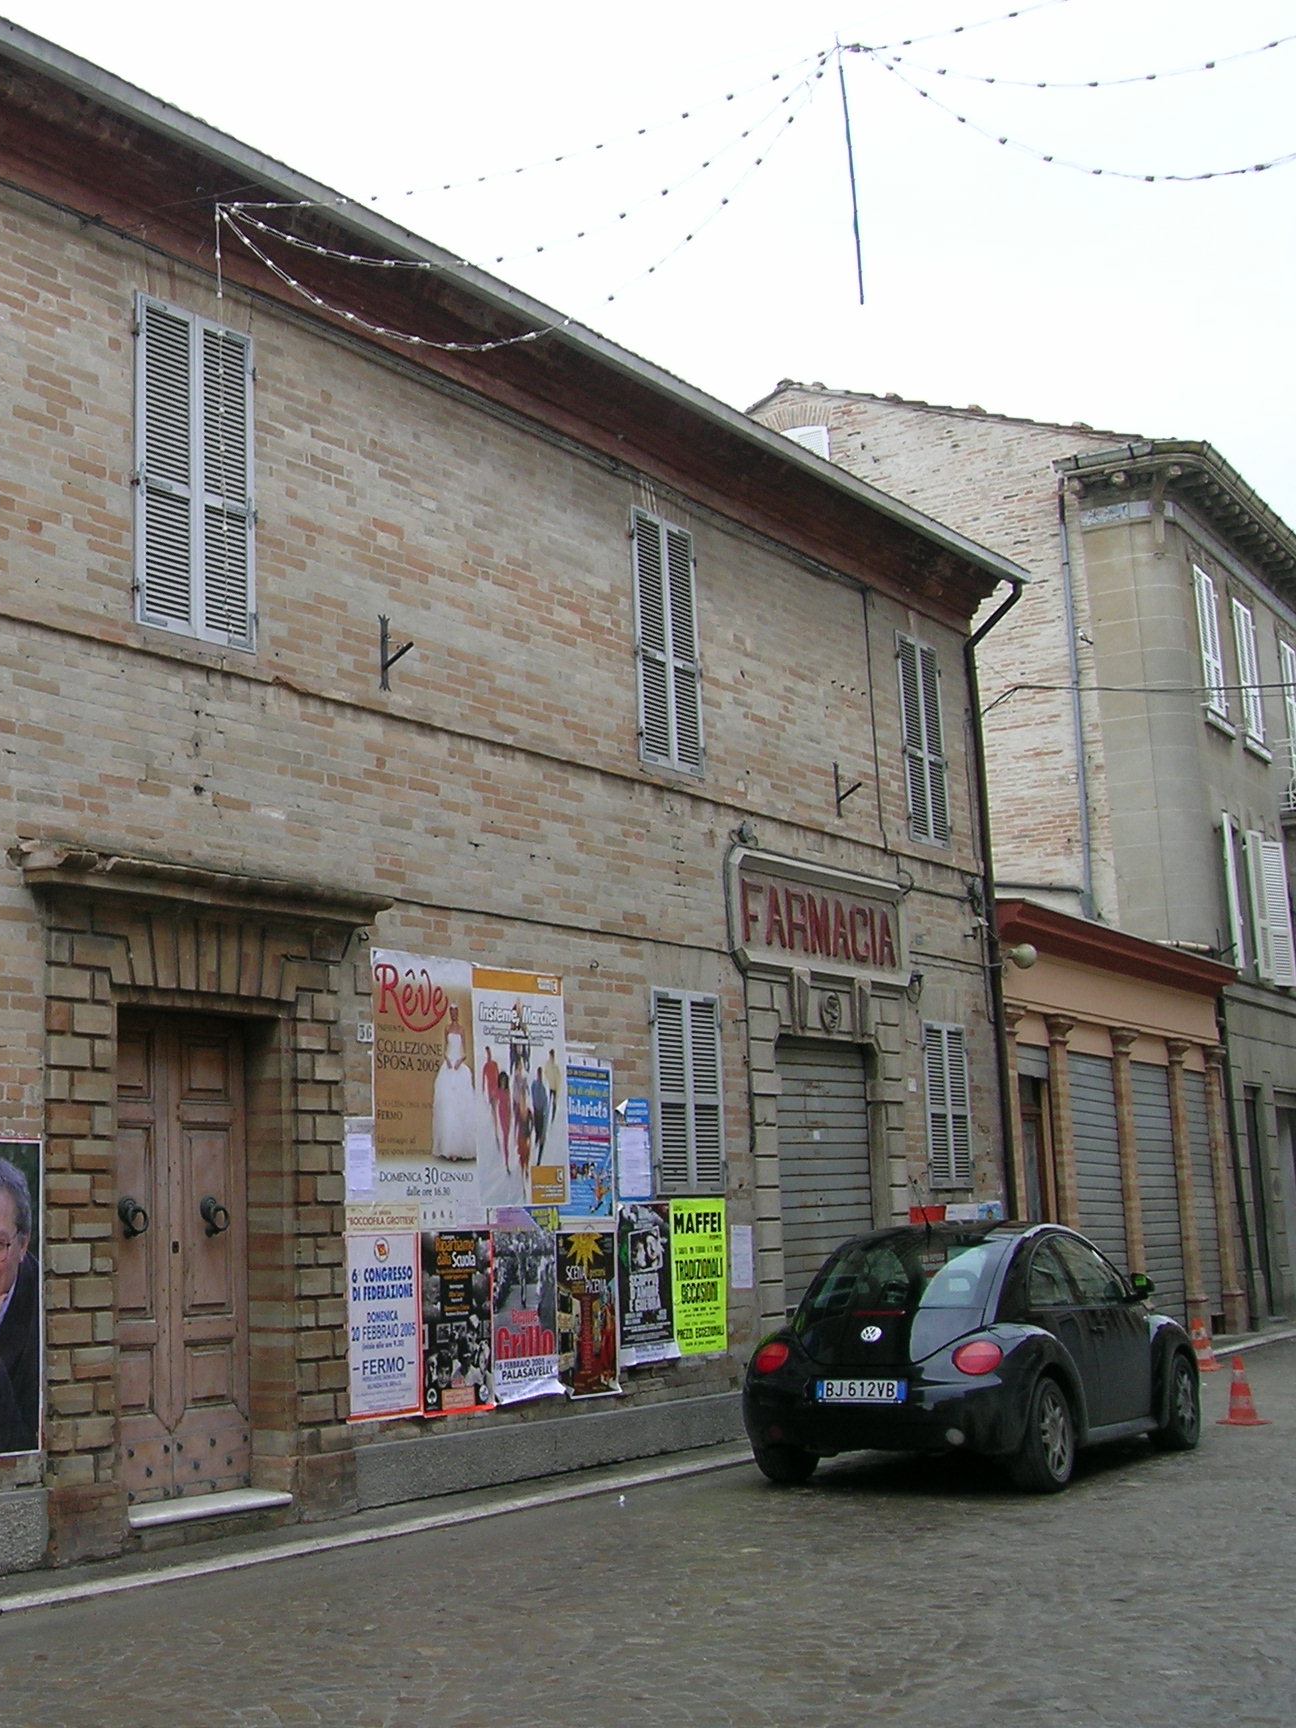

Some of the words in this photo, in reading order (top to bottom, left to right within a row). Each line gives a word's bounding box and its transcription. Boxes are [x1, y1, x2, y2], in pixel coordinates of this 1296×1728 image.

[740, 877, 897, 968] FARMACIA
[374, 963, 448, 1032] Rêve
[376, 1038, 443, 1057] COLLEZIONE
[376, 1053, 414, 1071] SPOSA
[417, 1058, 440, 1072] 2005
[377, 1109, 403, 1120] FERMO
[379, 1171, 422, 1183] DOMENICA
[424, 1167, 439, 1185] 30
[440, 1172, 473, 1183] GENNAIO
[406, 1186, 421, 1196] dalle
[422, 1188, 432, 1196] ore
[674, 1212, 721, 1234] MAFFEI
[452, 1251, 476, 1268] Scuola
[364, 1266, 413, 1283] CONGRESSO
[675, 1258, 723, 1281] TRADIZIONALI
[352, 1286, 360, 1301] DI
[363, 1283, 413, 1301] FEDERAZIONE
[681, 1281, 718, 1304] OCCASIONI
[367, 1310, 398, 1323] DOMENICA
[351, 1326, 361, 1341] 20
[362, 1323, 399, 1340] FEBBRAIO
[400, 1322, 416, 1337] 2005
[496, 1325, 555, 1360] Grillo
[362, 1356, 405, 1375] FERMO
[504, 1359, 531, 1370] FEBBRAIO
[826, 1382, 843, 1397] BJ
[848, 1382, 895, 1397] 612VB
